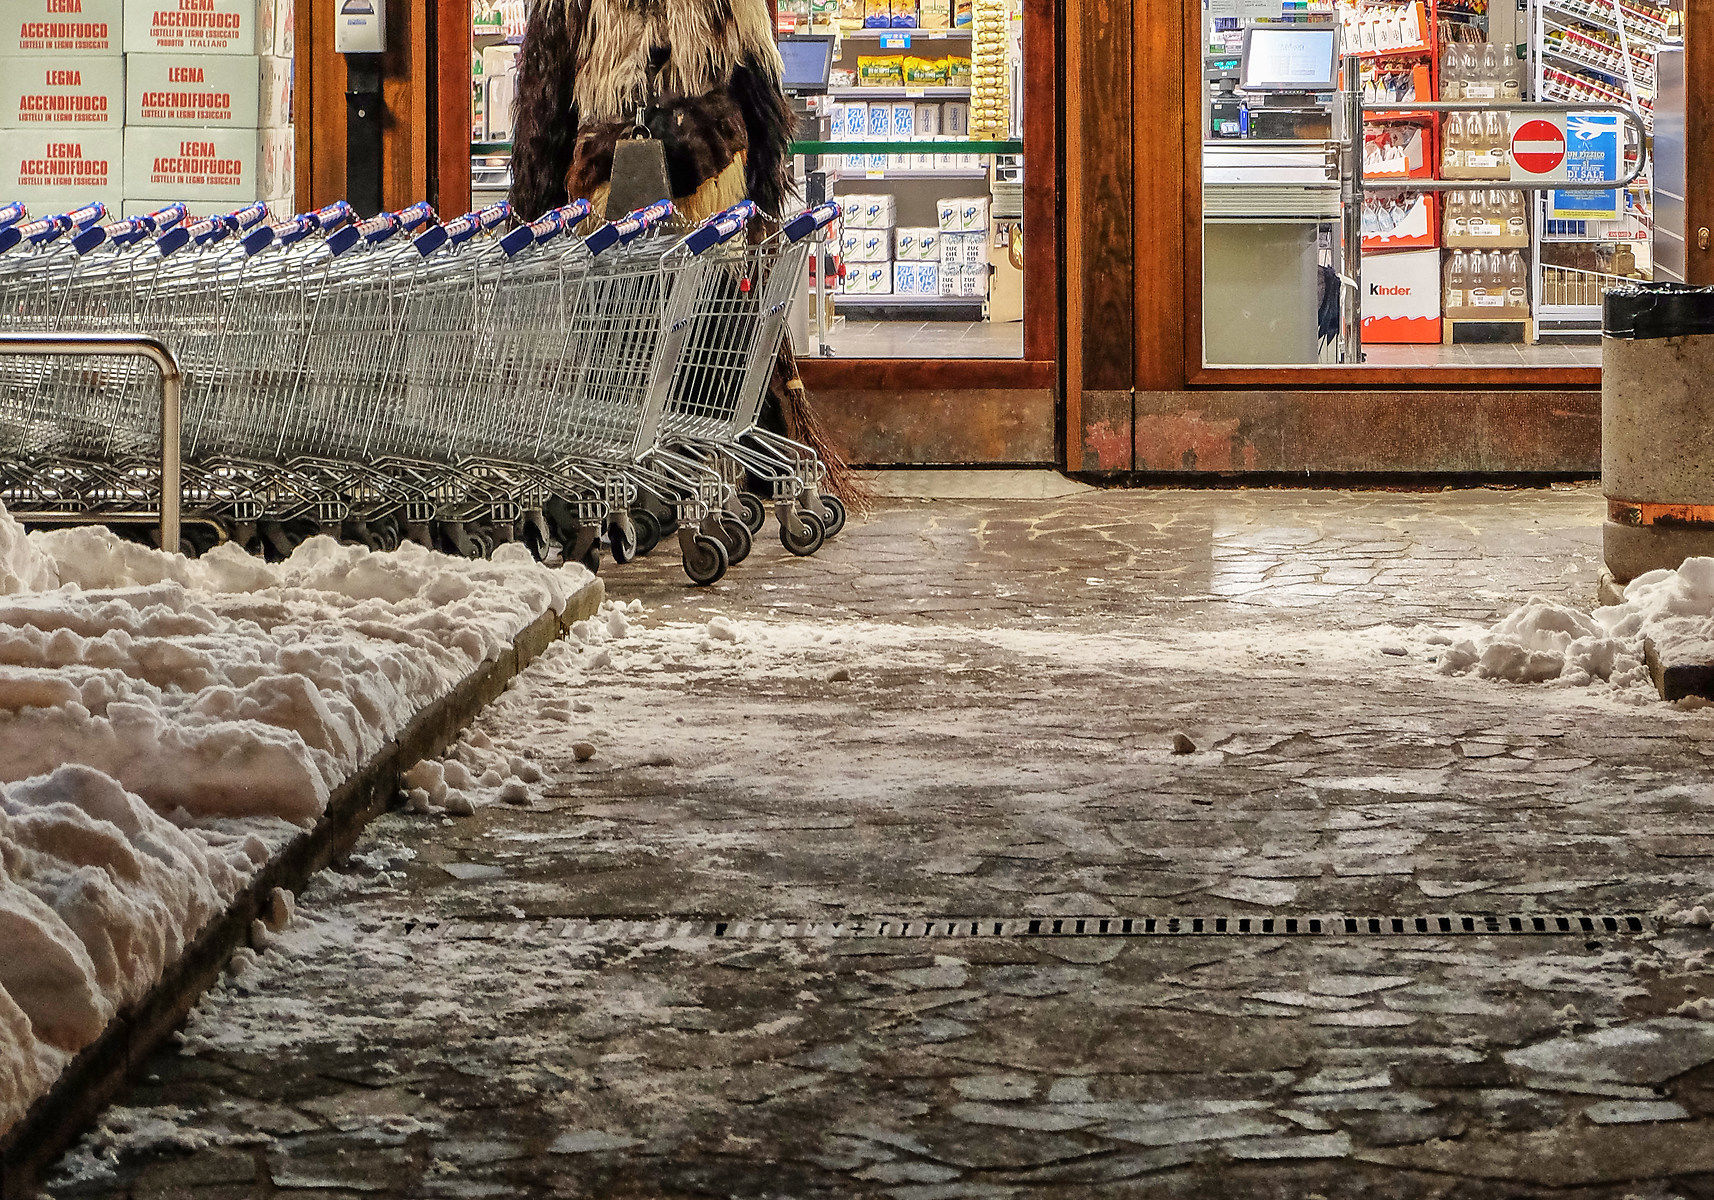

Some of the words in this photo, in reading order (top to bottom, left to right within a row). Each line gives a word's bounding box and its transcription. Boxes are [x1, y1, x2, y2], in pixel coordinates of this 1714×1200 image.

[152, 11, 240, 28] ACCENDIFUOCO
[21, 23, 108, 38] ACCENDIFUOCO
[150, 29, 174, 37] LISTELLI
[185, 30, 204, 38] LEGNO
[206, 30, 239, 38] ESSICCATO
[20, 41, 44, 49] LISTELLI
[46, 41, 52, 49] IN
[55, 41, 73, 49] LEGNO
[75, 41, 108, 49] ESSICCATO
[157, 39, 183, 47] PRODOTTO
[46, 70, 81, 86] LEGNA
[169, 68, 204, 82] LEGNA
[20, 96, 107, 110] ACCENDIFUOCO
[142, 92, 230, 108] ACCENDIFUOCO
[19, 113, 43, 121] LISTELLI
[45, 113, 51, 121] IN
[54, 113, 72, 121] LEGNO
[75, 113, 108, 121] ESSICCATO
[142, 110, 165, 118] LISTELLI
[168, 110, 174, 118] IN
[177, 110, 195, 118] LEGNO
[198, 111, 231, 119] ESSICCATO
[47, 144, 81, 158] LEGNA
[180, 142, 215, 157] LEGNA
[20, 160, 108, 175] ACCENDIFUOCO
[153, 158, 241, 174] ACCENDIFUOCO
[18, 177, 42, 185] LISTELLI
[45, 177, 51, 185] IN
[53, 177, 71, 185] LEGNO
[74, 177, 107, 185] ESSICCATO
[151, 175, 175, 183] LISTELLI
[186, 176, 204, 184] LEGNO
[207, 177, 240, 185] ESSICCATO
[1568, 170, 1577, 178] DI
